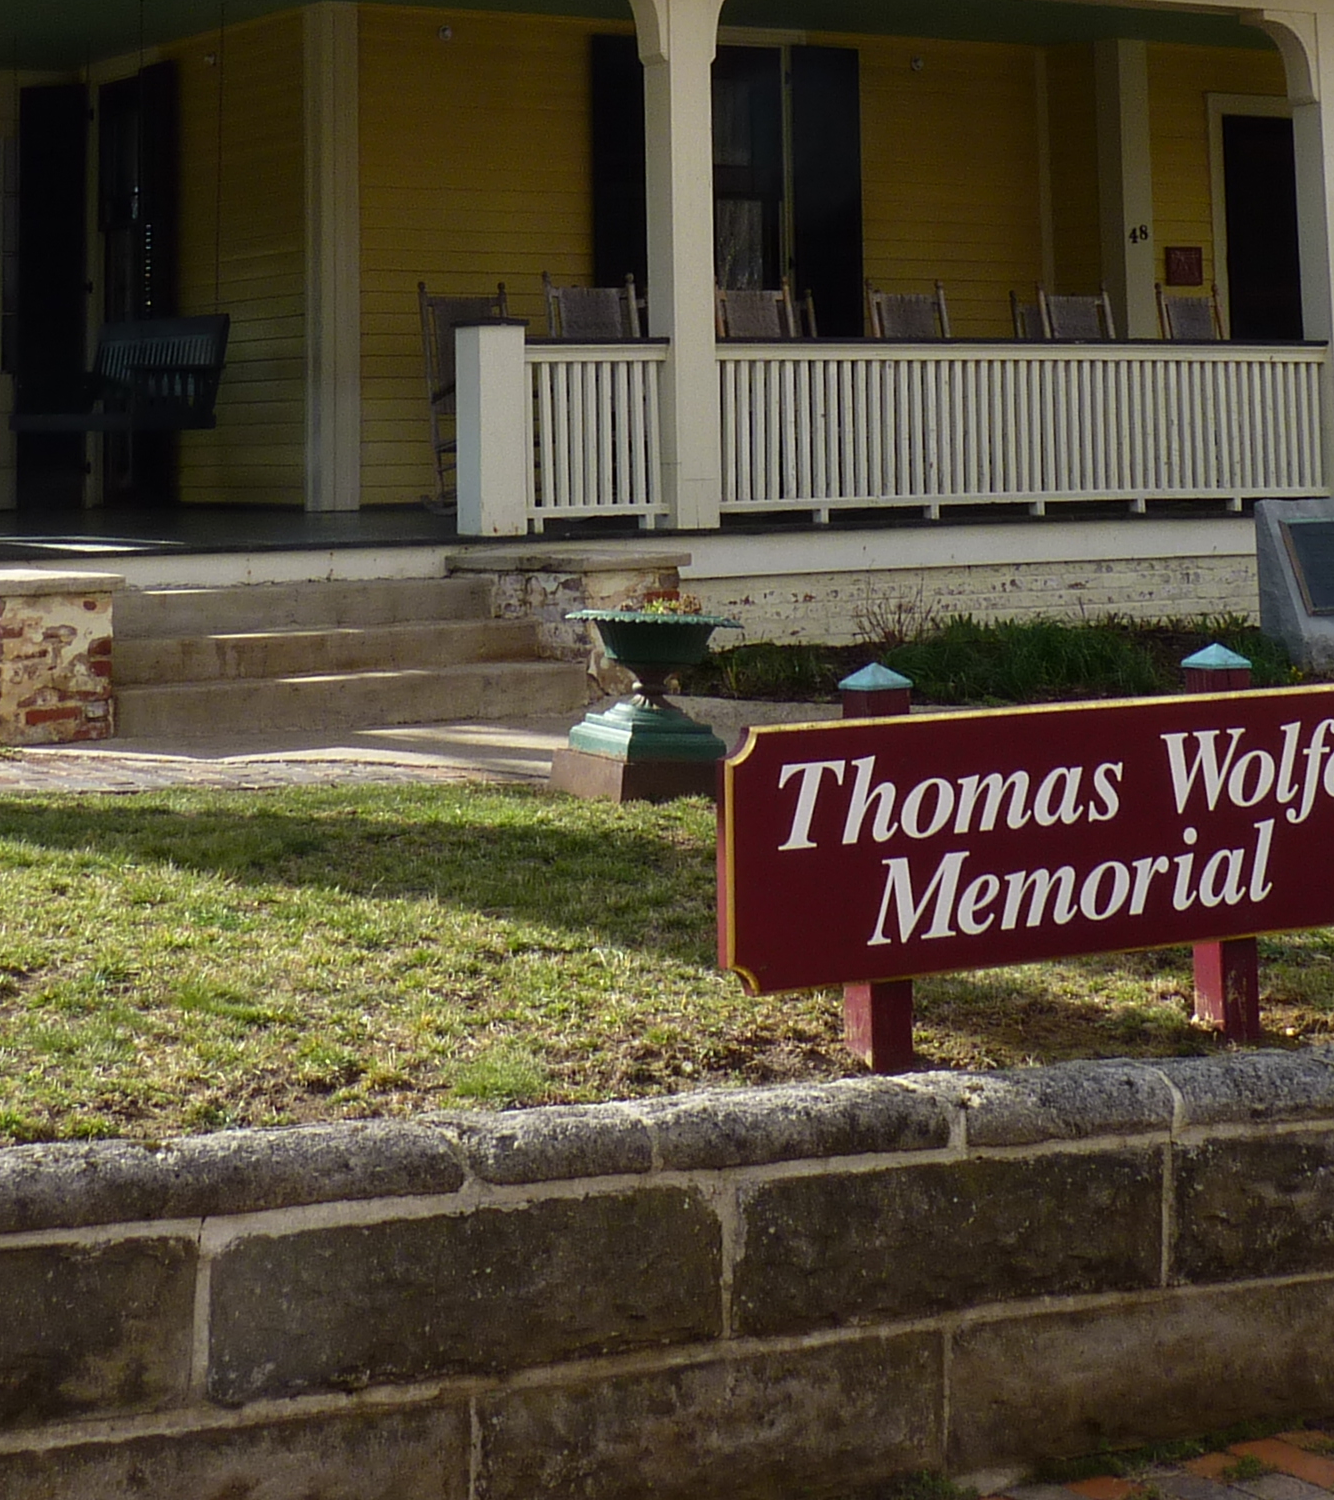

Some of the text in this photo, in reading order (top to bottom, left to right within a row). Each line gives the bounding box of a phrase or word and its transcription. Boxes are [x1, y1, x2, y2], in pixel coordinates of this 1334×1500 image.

[1128, 224, 1149, 244] 48
[777, 755, 1124, 852] Thomas
[867, 818, 1275, 946] Memorial
